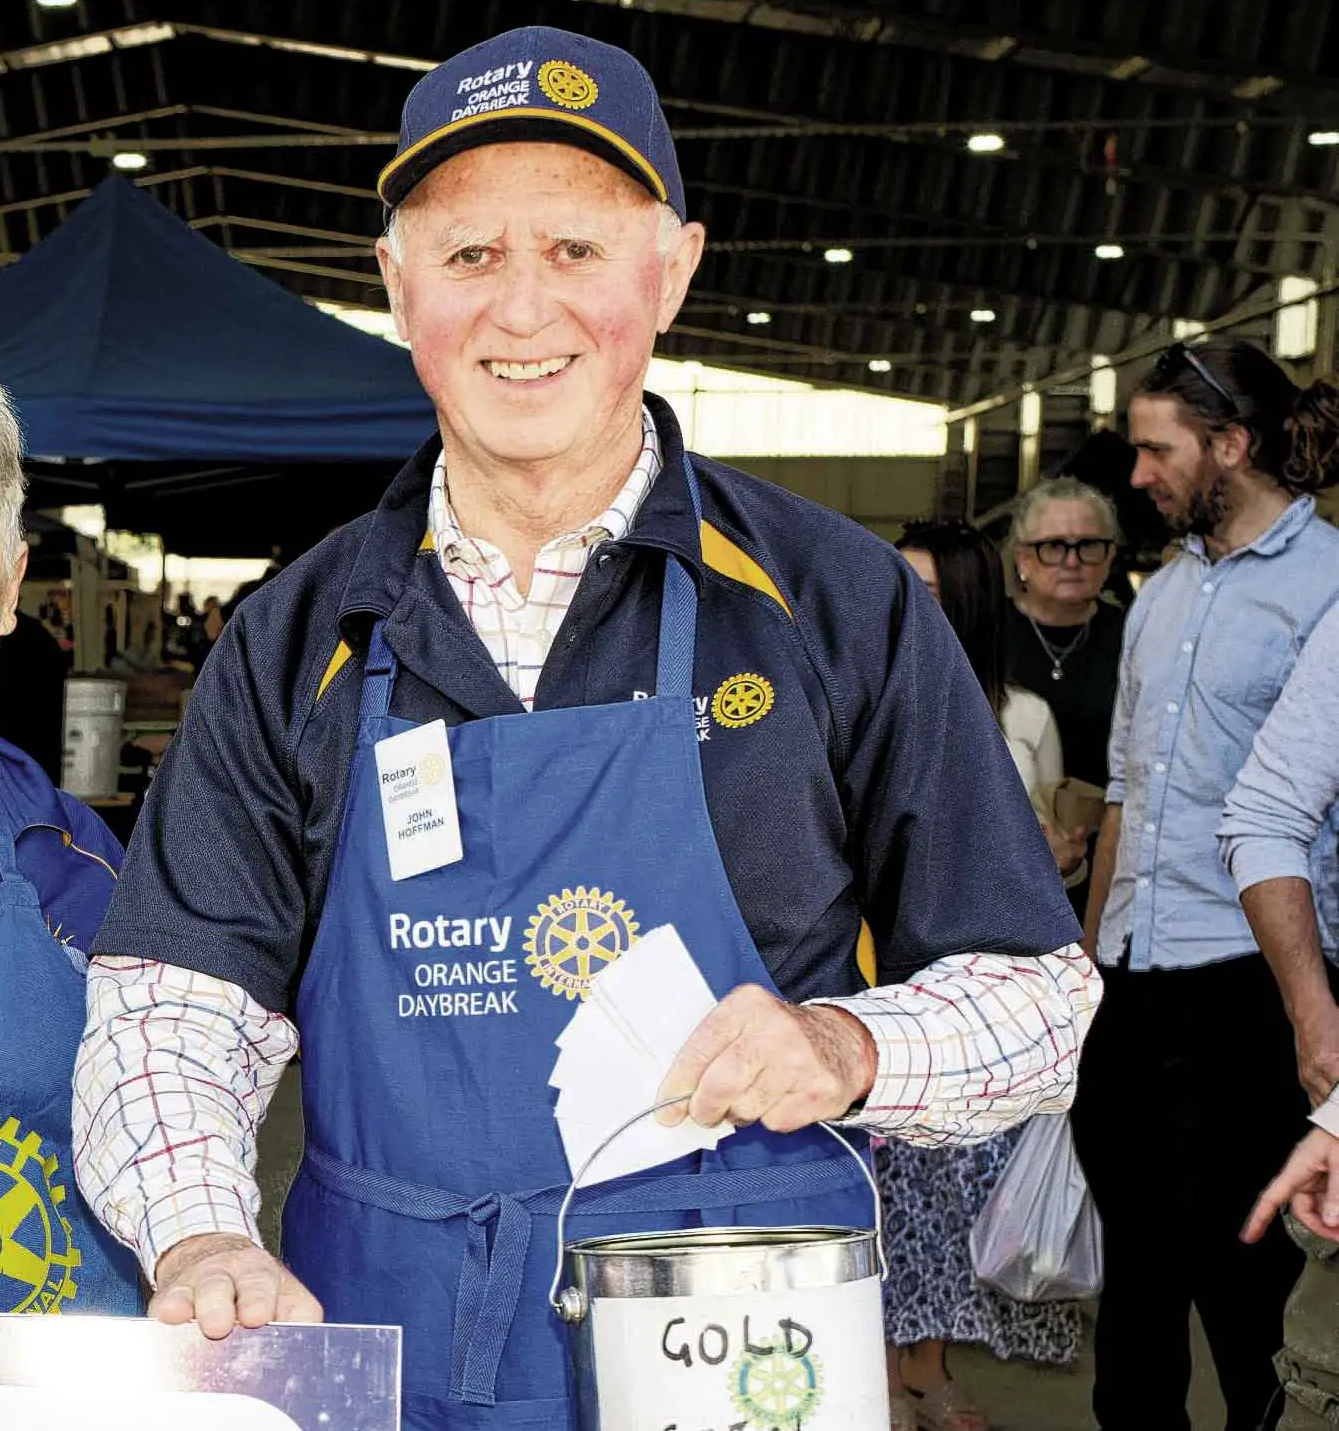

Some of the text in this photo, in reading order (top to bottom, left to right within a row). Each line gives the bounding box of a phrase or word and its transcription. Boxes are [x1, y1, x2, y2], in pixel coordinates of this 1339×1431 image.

[456, 60, 534, 94] Rotary
[467, 80, 530, 105] ORANGE
[450, 92, 530, 123] DAYBREAK
[382, 766, 416, 785] Rotary
[397, 816, 445, 841] HOFFMAN
[407, 808, 433, 825] JOHN
[389, 912, 512, 953] Rotary
[414, 959, 518, 988] ORANGE
[397, 991, 519, 1018] DAYBREAK
[662, 1313, 814, 1368] GOLD
